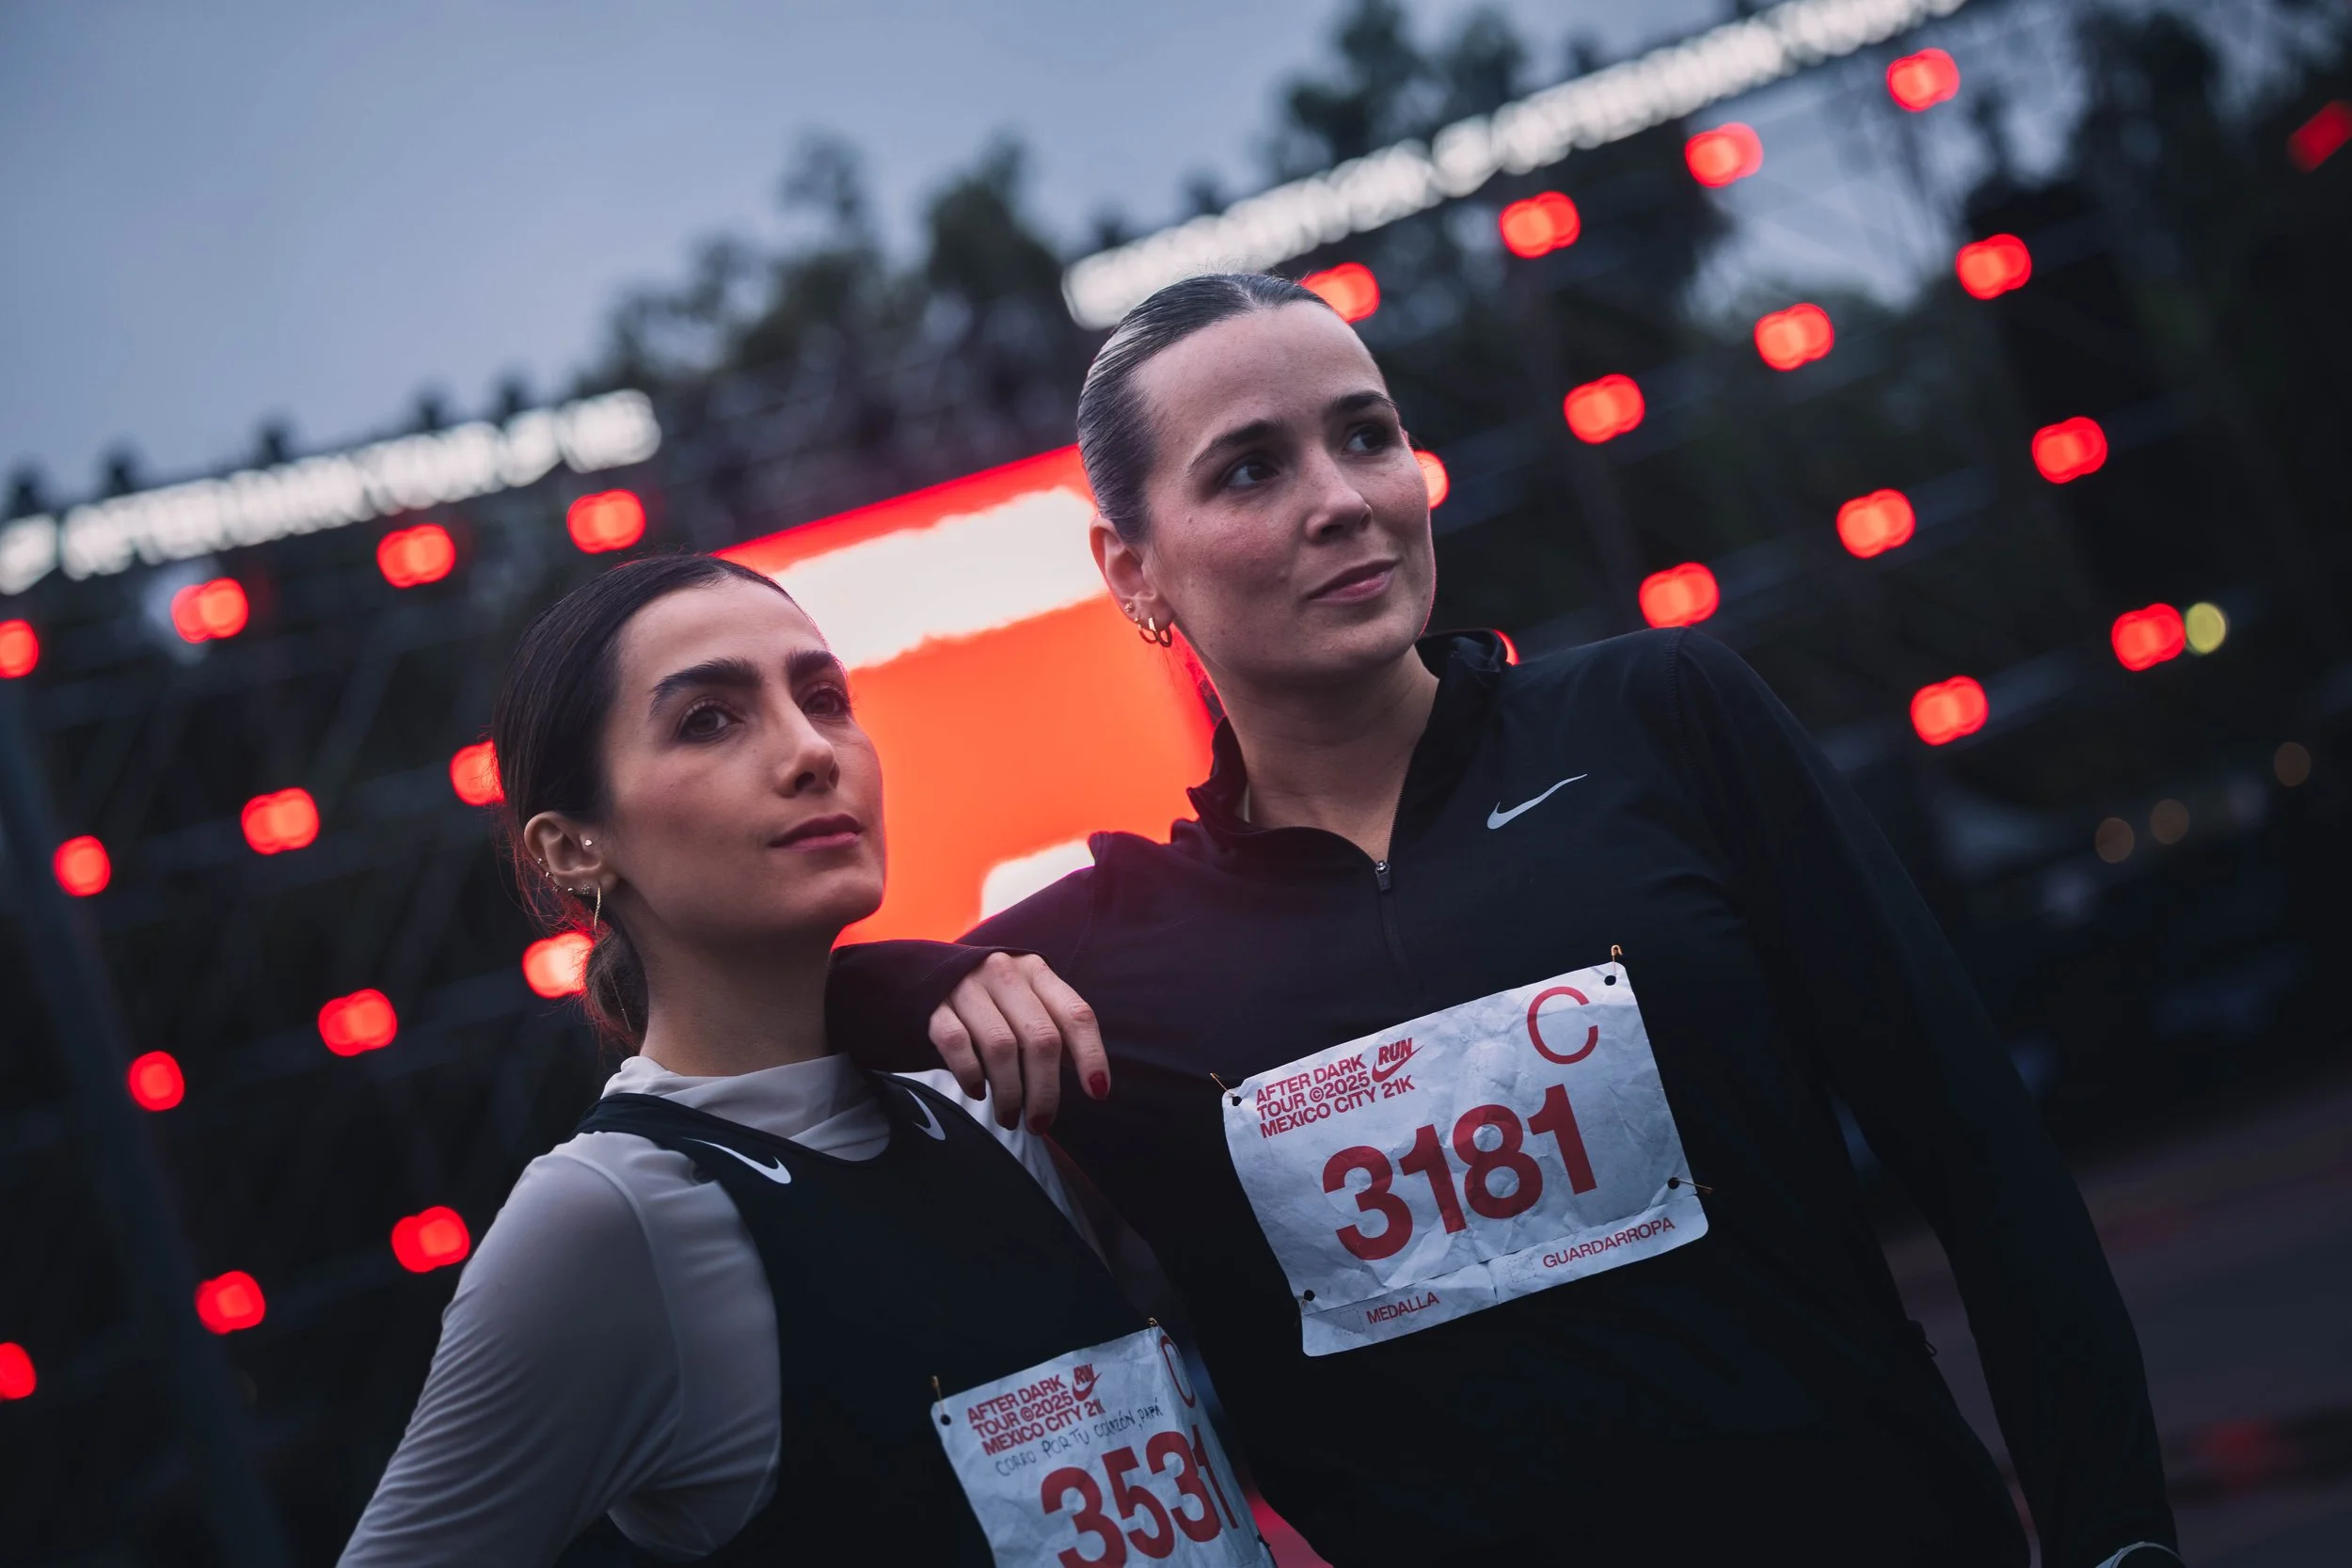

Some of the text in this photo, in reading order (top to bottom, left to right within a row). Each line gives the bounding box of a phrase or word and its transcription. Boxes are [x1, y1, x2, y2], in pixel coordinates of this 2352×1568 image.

[1527, 986, 1598, 1065] C
[1378, 1037, 1413, 1066] RUN
[1256, 1053, 1366, 1106] AFTER DARK
[1257, 1070, 1371, 1120] TOUR ©2025
[1260, 1074, 1416, 1138] MEXICO CITY 21K
[1322, 1083, 1597, 1261] 3181
[1542, 1216, 1676, 1270] GUARDARROPA
[1366, 1291, 1440, 1324] MEDALLA
[967, 1374, 1067, 1424] AFTER DARK
[972, 1411, 1021, 1439] TOUR
[981, 1422, 1044, 1456] MEXICO
[1045, 1405, 1083, 1433] CITY
[1041, 1435, 1073, 1460] POR
[1070, 1428, 1090, 1446] TU
[1041, 1424, 1239, 1568] 3531
